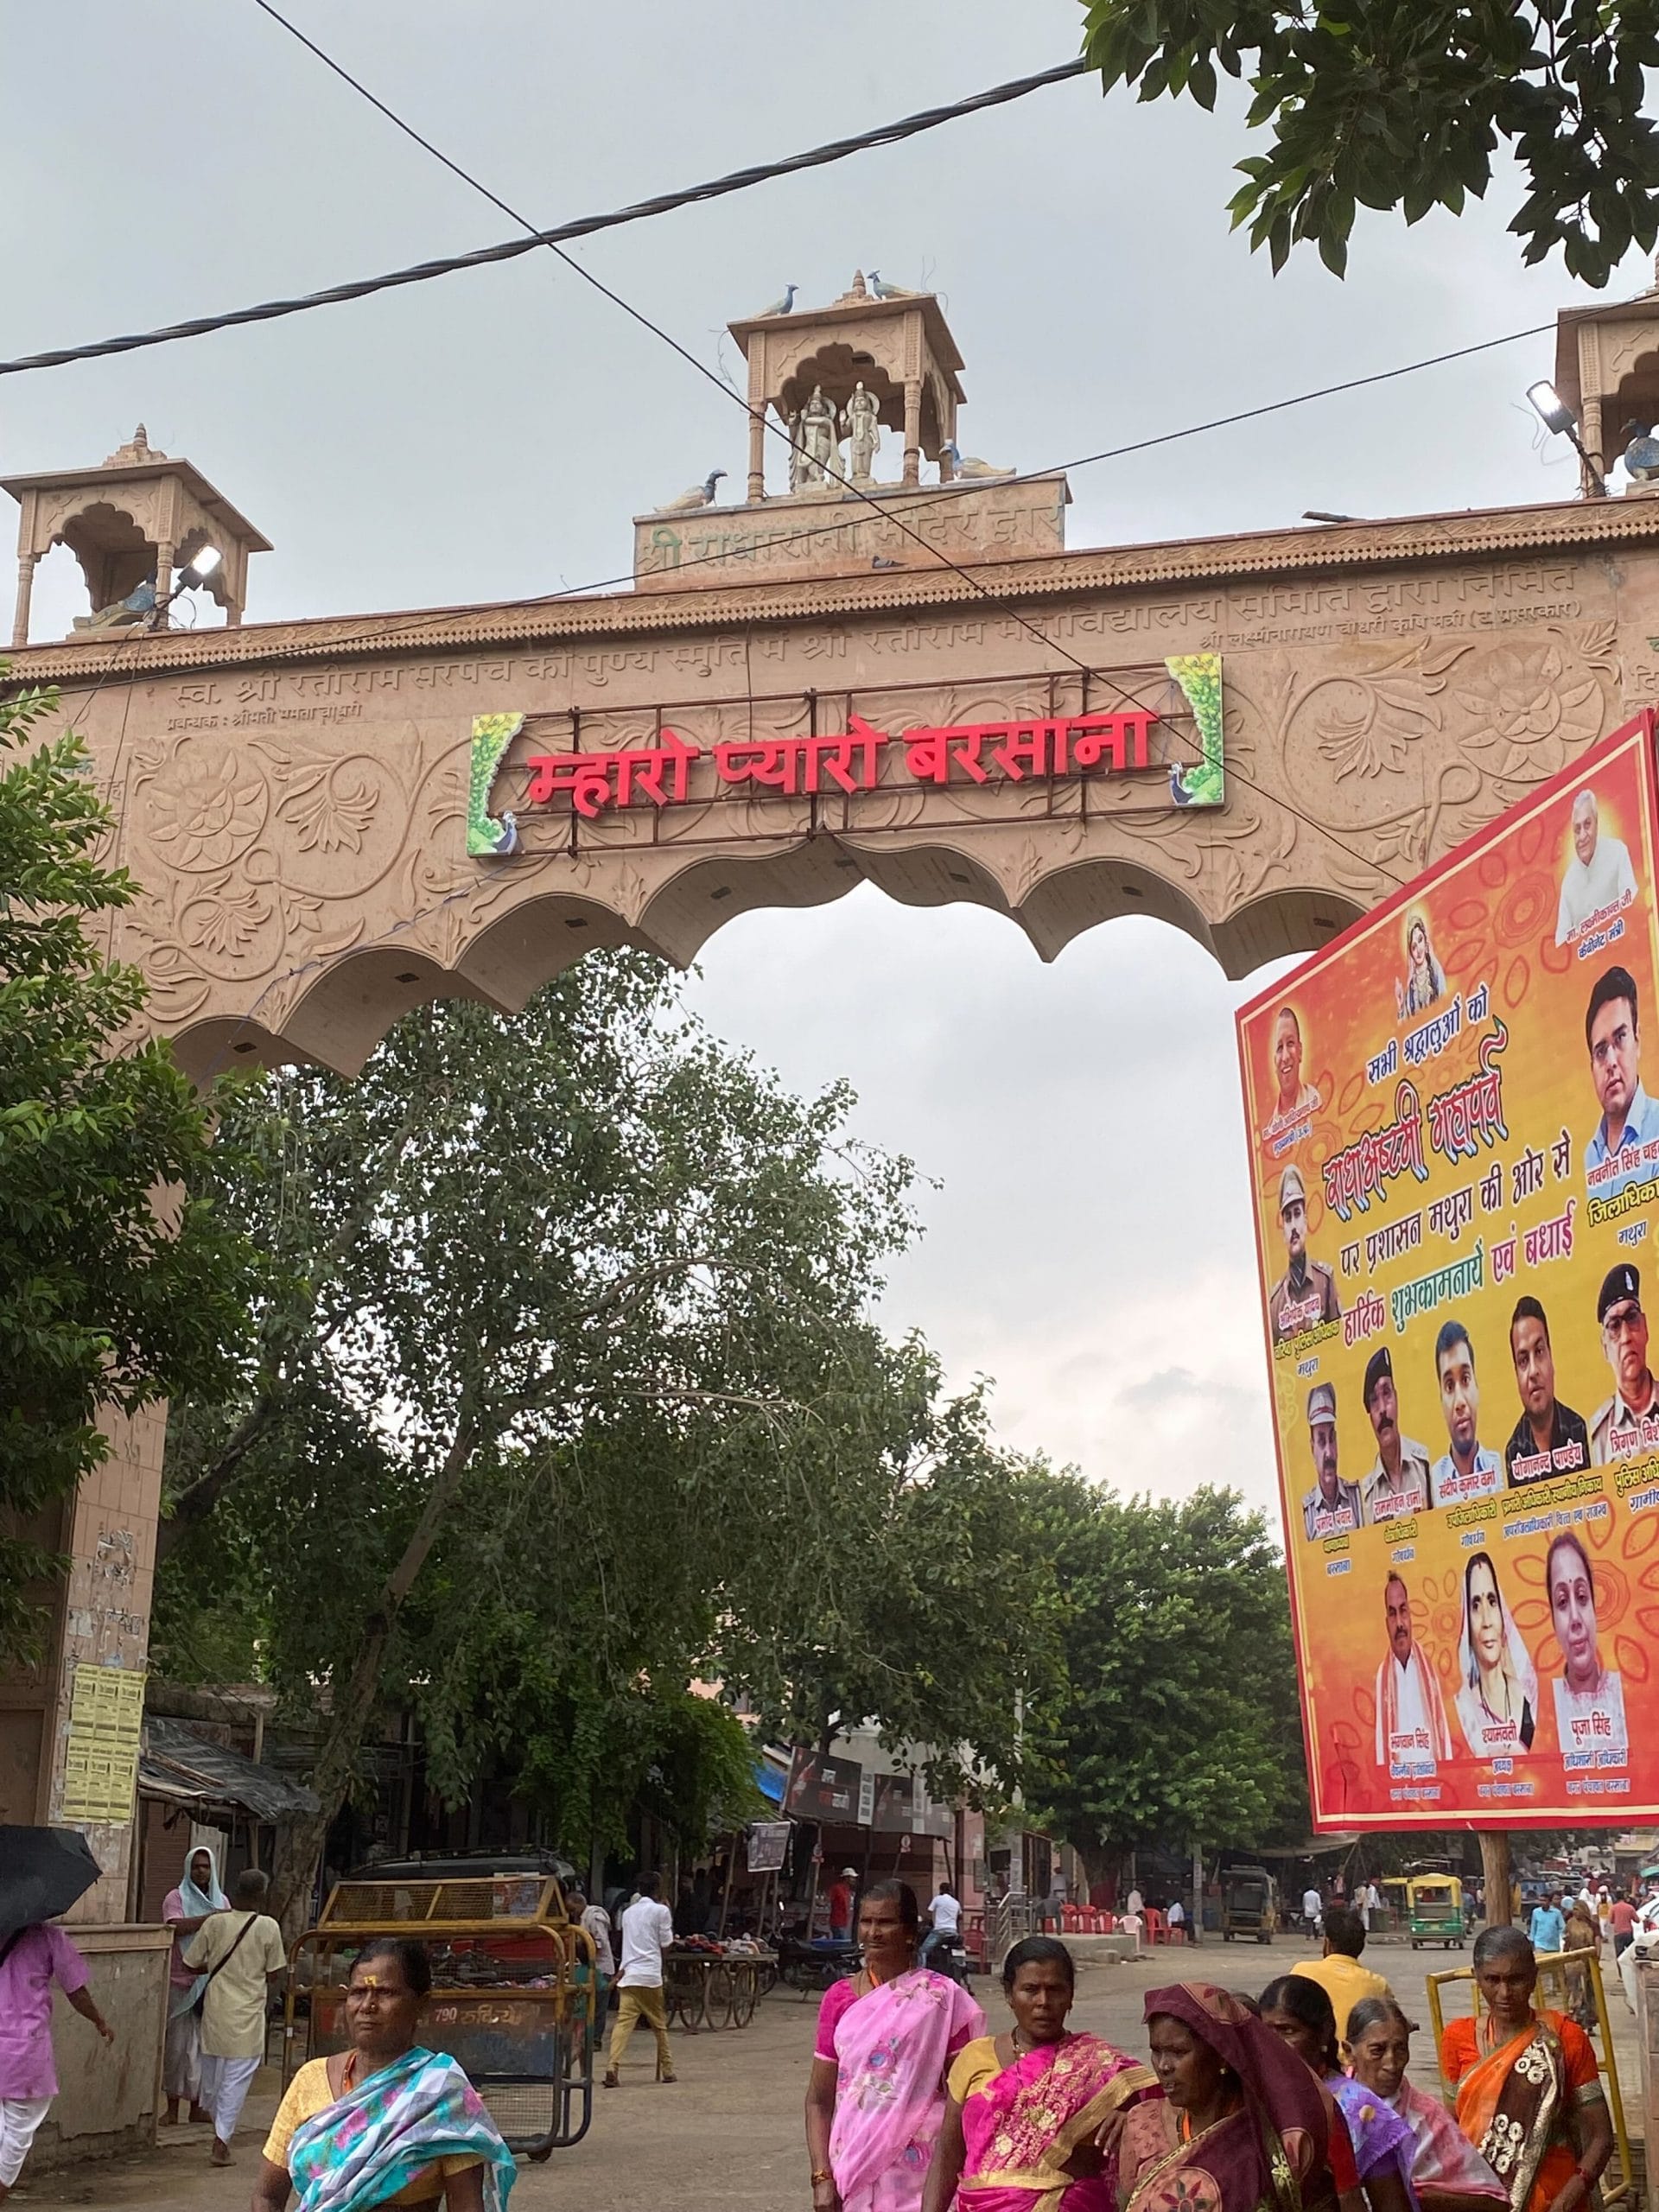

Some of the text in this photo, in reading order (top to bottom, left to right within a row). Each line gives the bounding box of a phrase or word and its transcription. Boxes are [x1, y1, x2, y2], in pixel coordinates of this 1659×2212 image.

[987, 505, 1063, 544] द्वार
[235, 669, 281, 703] श्री
[289, 664, 404, 697] रतीराम
[410, 652, 516, 690] सरपंच
[521, 645, 576, 681] की
[580, 650, 659, 688] पुण्य
[665, 632, 748, 677] स्मृति
[800, 623, 852, 660] श्री
[995, 597, 1222, 645] महाविद्यालय
[1230, 581, 1353, 621] समिति
[1360, 581, 1446, 614] द्वारा
[526, 708, 1161, 818] म्हारो प्यारो बरसाना
[1367, 1039, 1397, 1084] सभी
[1467, 984, 1488, 1021] को
[1340, 1129, 1571, 1276] पर प्रशासन मथुरा की ओर से
[1587, 1156, 1619, 1186] नवनीत
[1621, 1145, 1641, 1173] सिंह
[1343, 1199, 1576, 1346] हार्दिक शुभकामनायें एवं बधाई
[1618, 1221, 1647, 1245] मथुरा
[1570, 1710, 1611, 1745] पूजा सिंह
